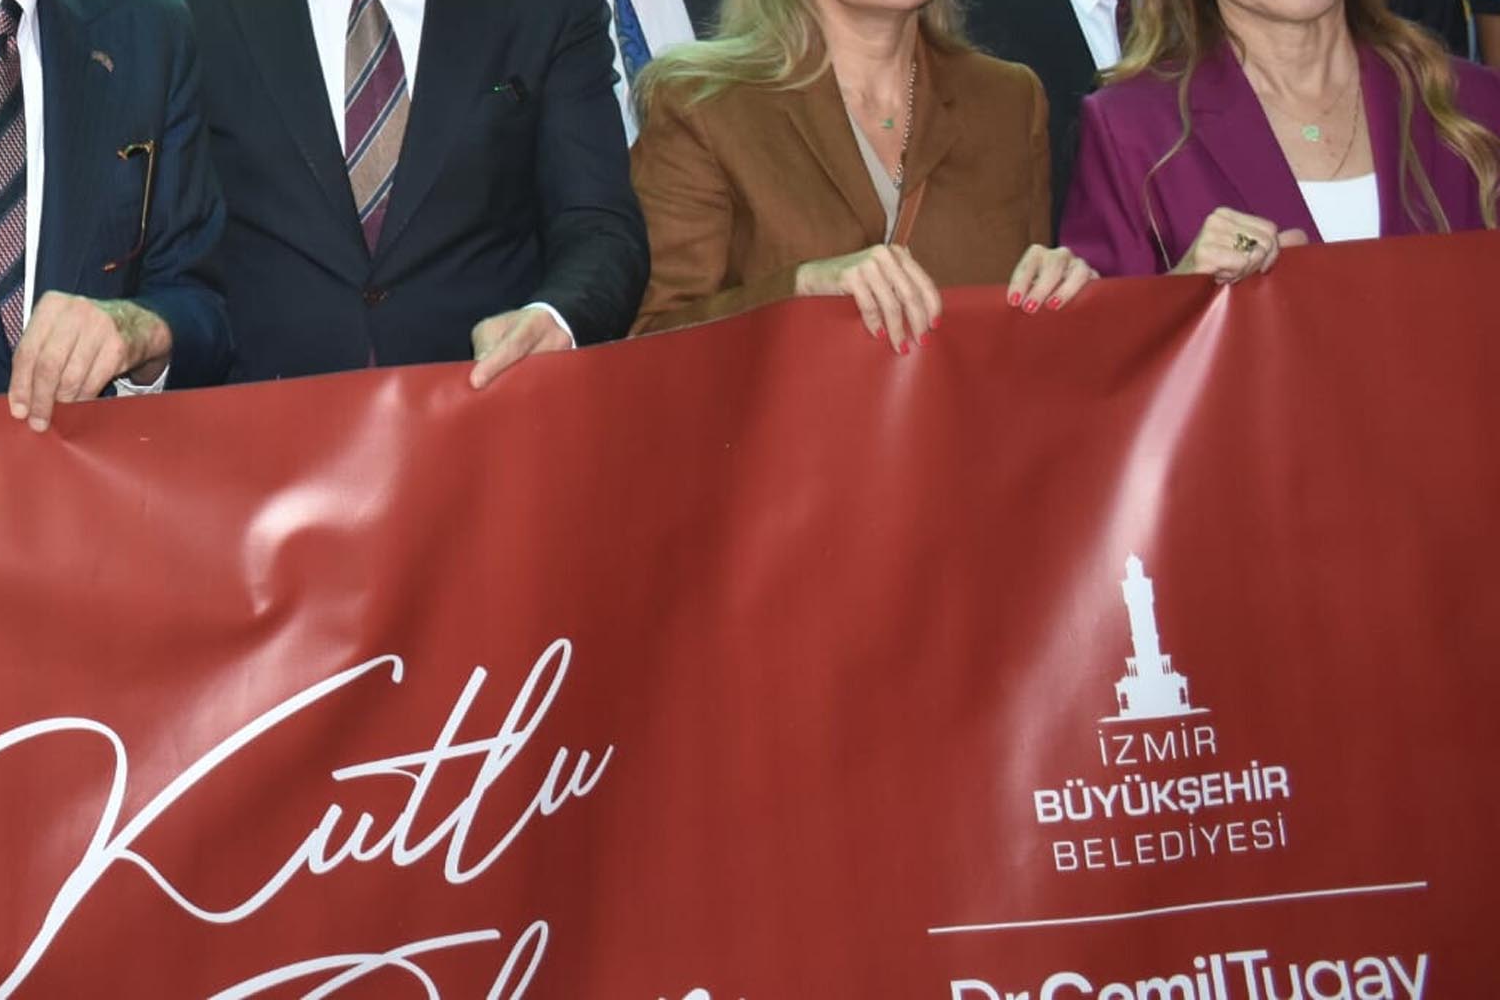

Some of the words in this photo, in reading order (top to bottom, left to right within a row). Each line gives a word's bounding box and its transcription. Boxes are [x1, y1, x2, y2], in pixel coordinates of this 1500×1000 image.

[1098, 722, 1217, 766] İZMİR
[1033, 760, 1290, 824] BÜYÜKŞEHİR
[1053, 811, 1287, 871] BELEDİYESİ
